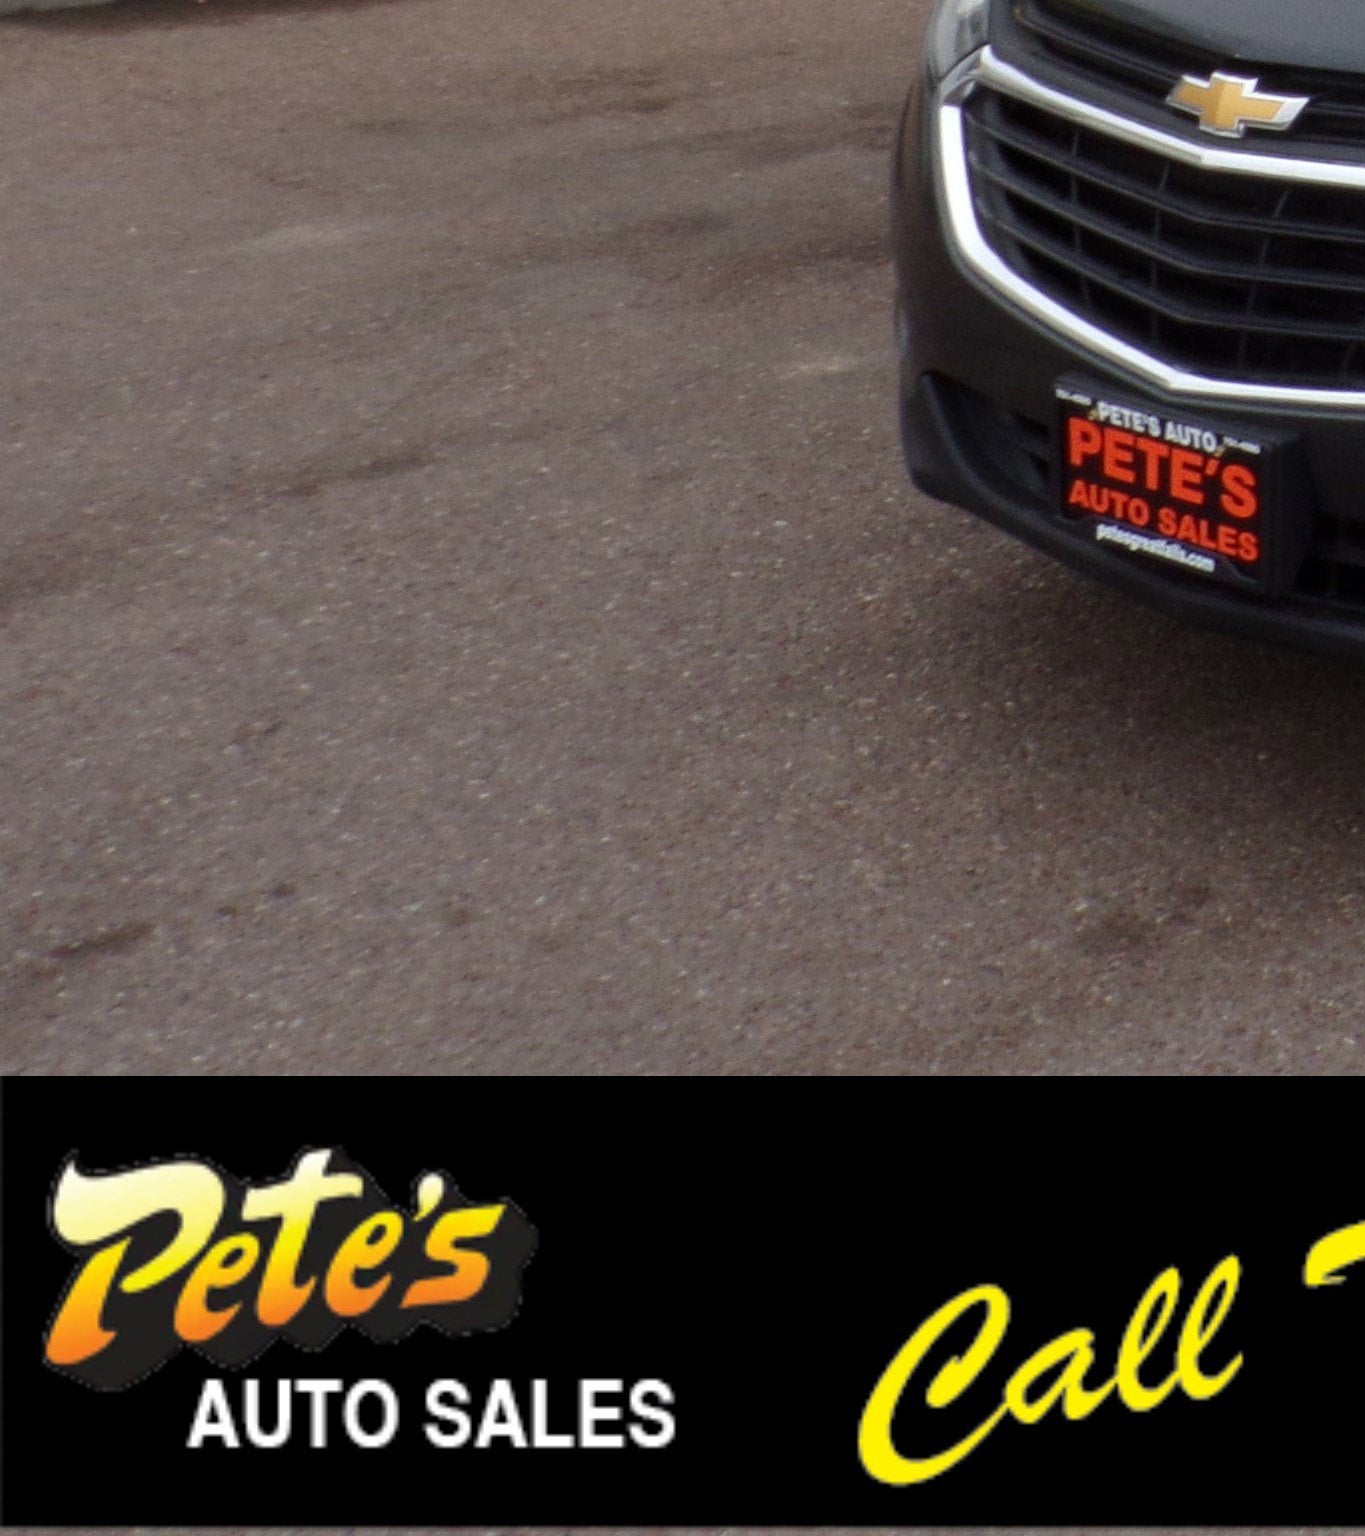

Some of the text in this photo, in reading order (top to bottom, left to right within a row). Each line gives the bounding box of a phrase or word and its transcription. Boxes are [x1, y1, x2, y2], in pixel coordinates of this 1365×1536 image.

[1069, 416, 1258, 519] PETE'S
[1097, 400, 1161, 438] PETE'S
[1164, 420, 1217, 454] AUTO
[1068, 478, 1259, 562] AUTO SALES
